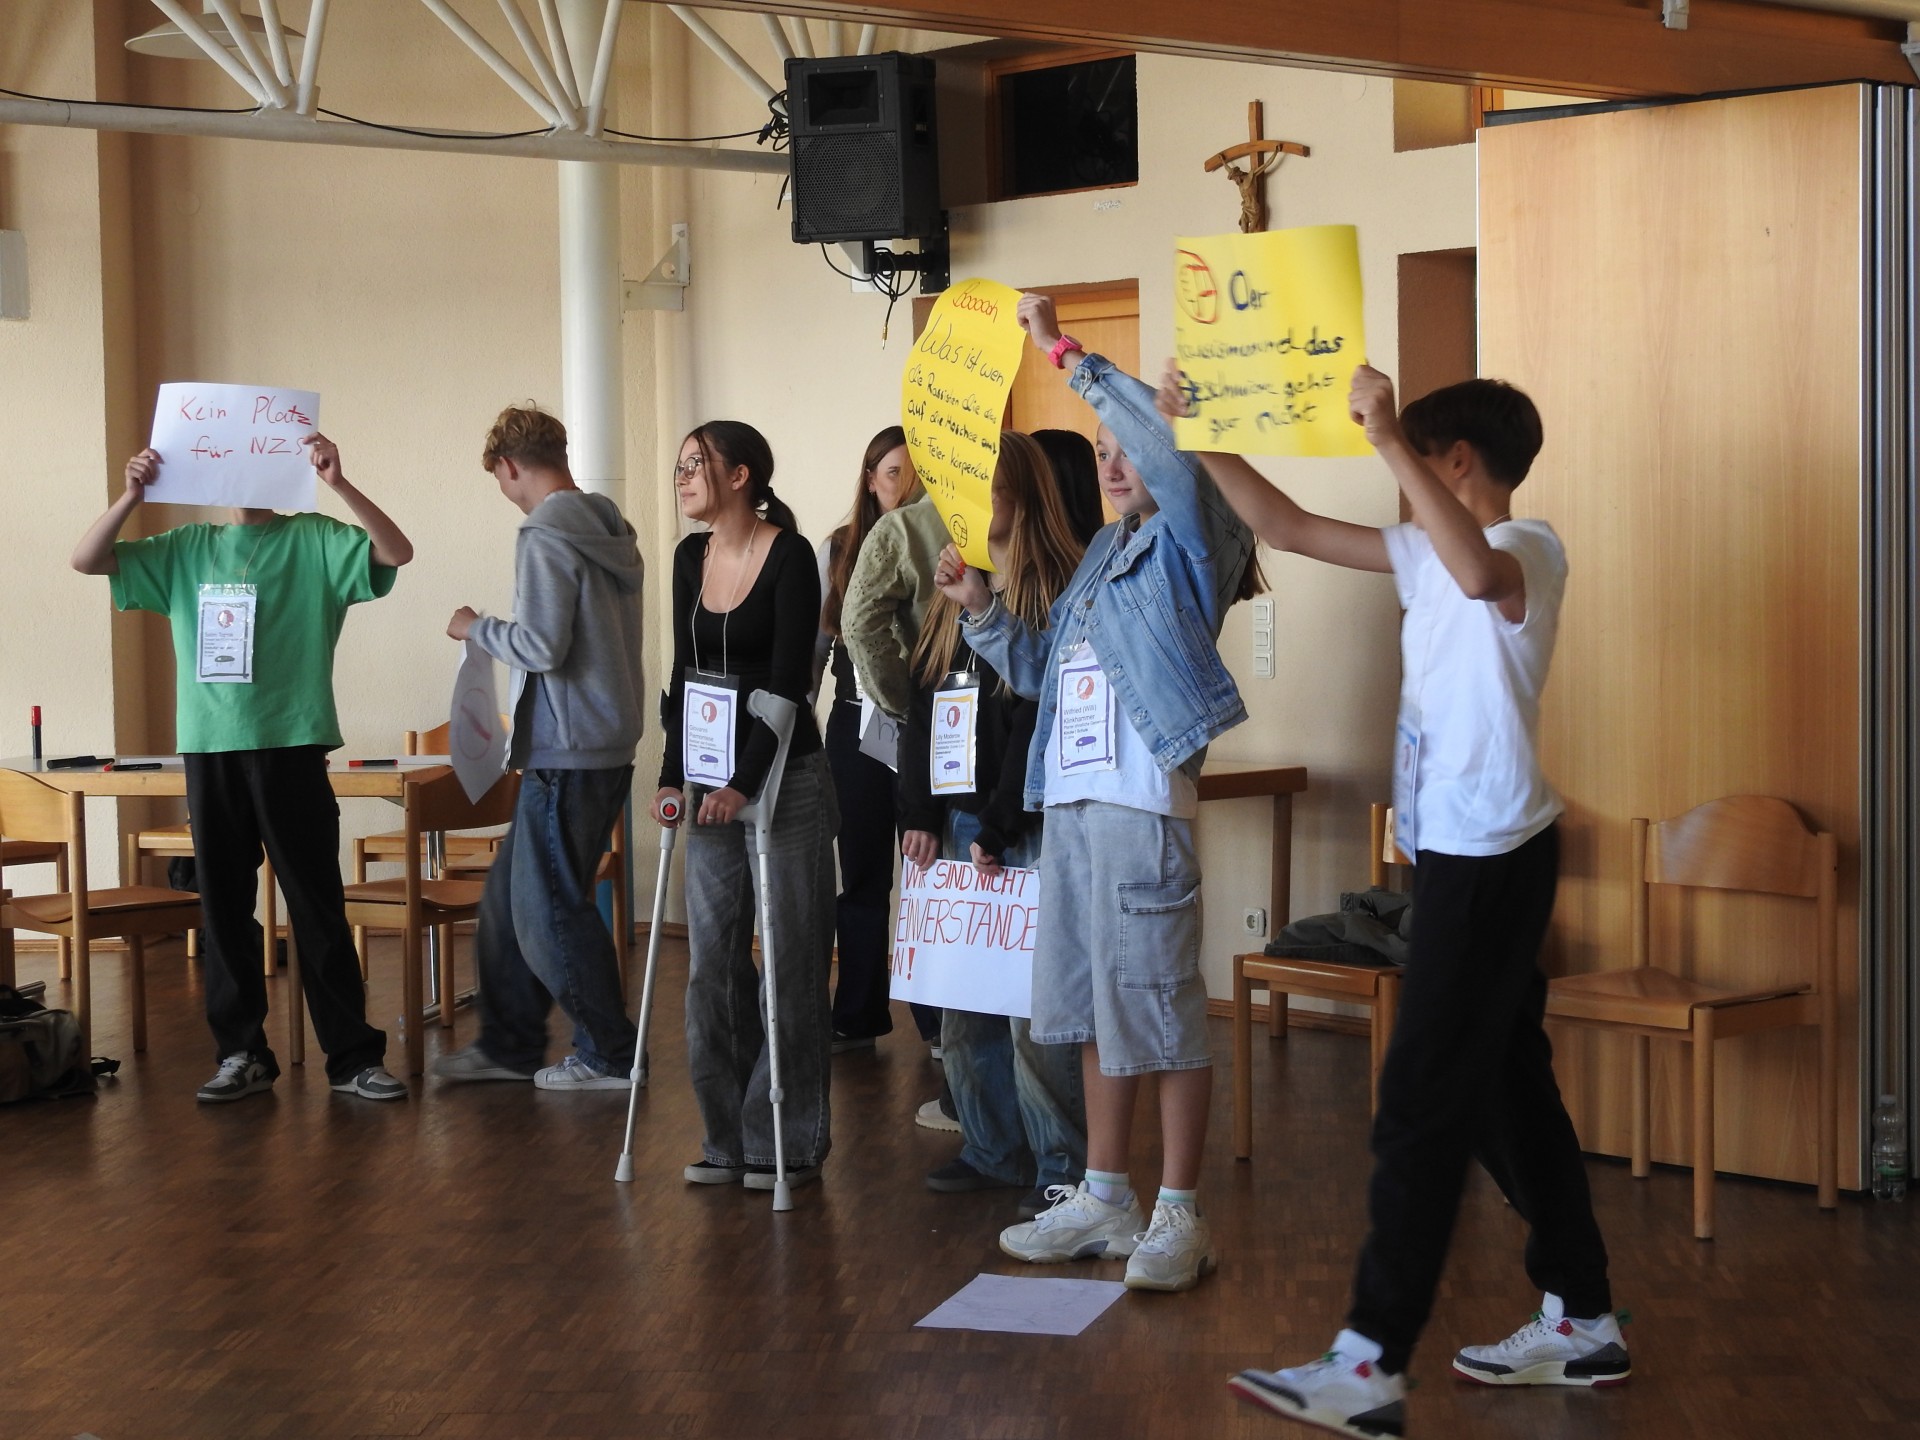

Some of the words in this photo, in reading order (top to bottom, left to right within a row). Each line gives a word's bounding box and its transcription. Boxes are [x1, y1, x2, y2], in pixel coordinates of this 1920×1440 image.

[920, 313, 963, 364] Was
[963, 347, 982, 373] ist
[1304, 325, 1344, 356] das
[908, 363, 923, 387] die
[962, 393, 980, 415] die
[180, 394, 227, 422] Kein
[252, 395, 312, 426] Platz
[907, 399, 927, 421] auf
[929, 410, 944, 427] die
[190, 435, 233, 461] für
[927, 436, 946, 461] Feier
